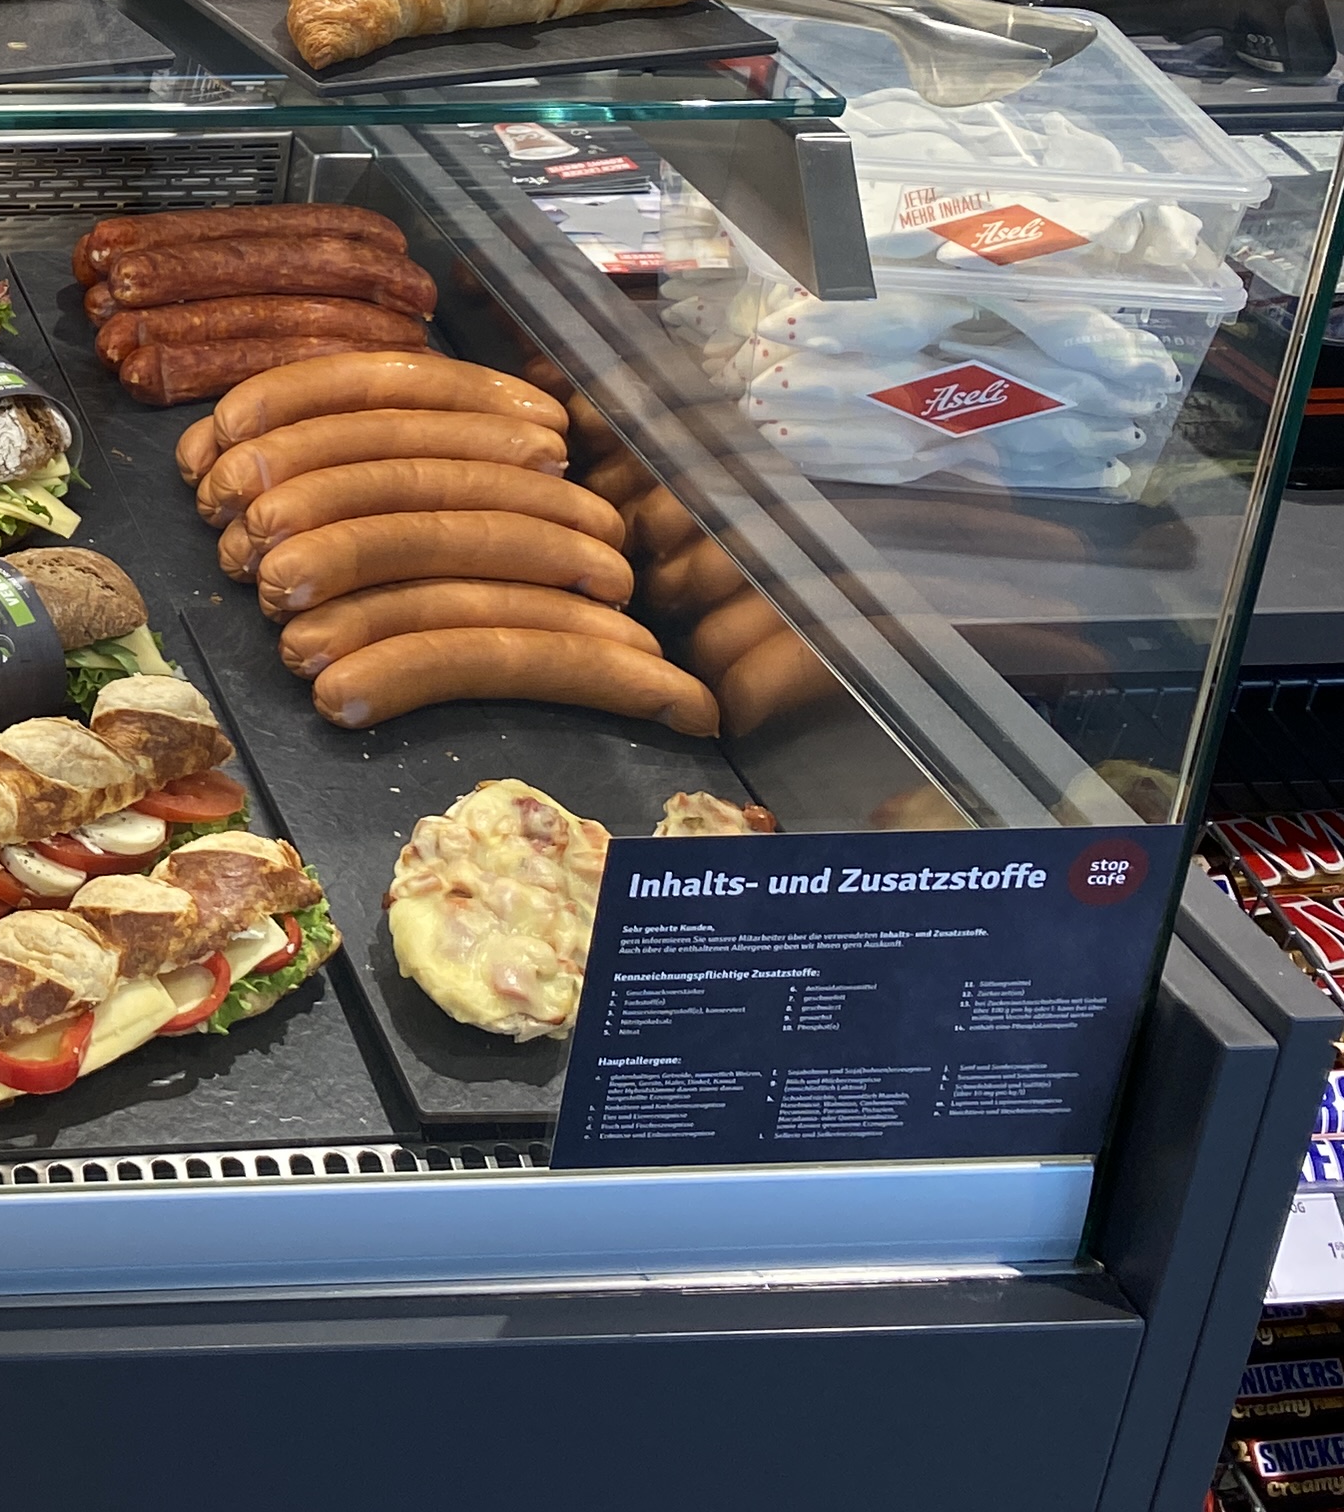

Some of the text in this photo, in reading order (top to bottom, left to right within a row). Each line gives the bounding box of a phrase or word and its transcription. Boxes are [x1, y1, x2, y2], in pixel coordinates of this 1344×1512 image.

[904, 187, 939, 211] JETZT
[899, 207, 937, 230] MEHR
[970, 217, 1046, 251] Aseli
[920, 379, 1010, 418] Aseli
[628, 862, 1047, 898] Inhalts- und Zusatzstoffe
[1087, 870, 1127, 887] cafe
[613, 967, 821, 983] Kennzeichnungspflichtige Zusatzstoffe:
[598, 1055, 683, 1068] Hauptallergene:
[1238, 1359, 1342, 1397] NICKERS
[1259, 1434, 1344, 1475] SNICKE
